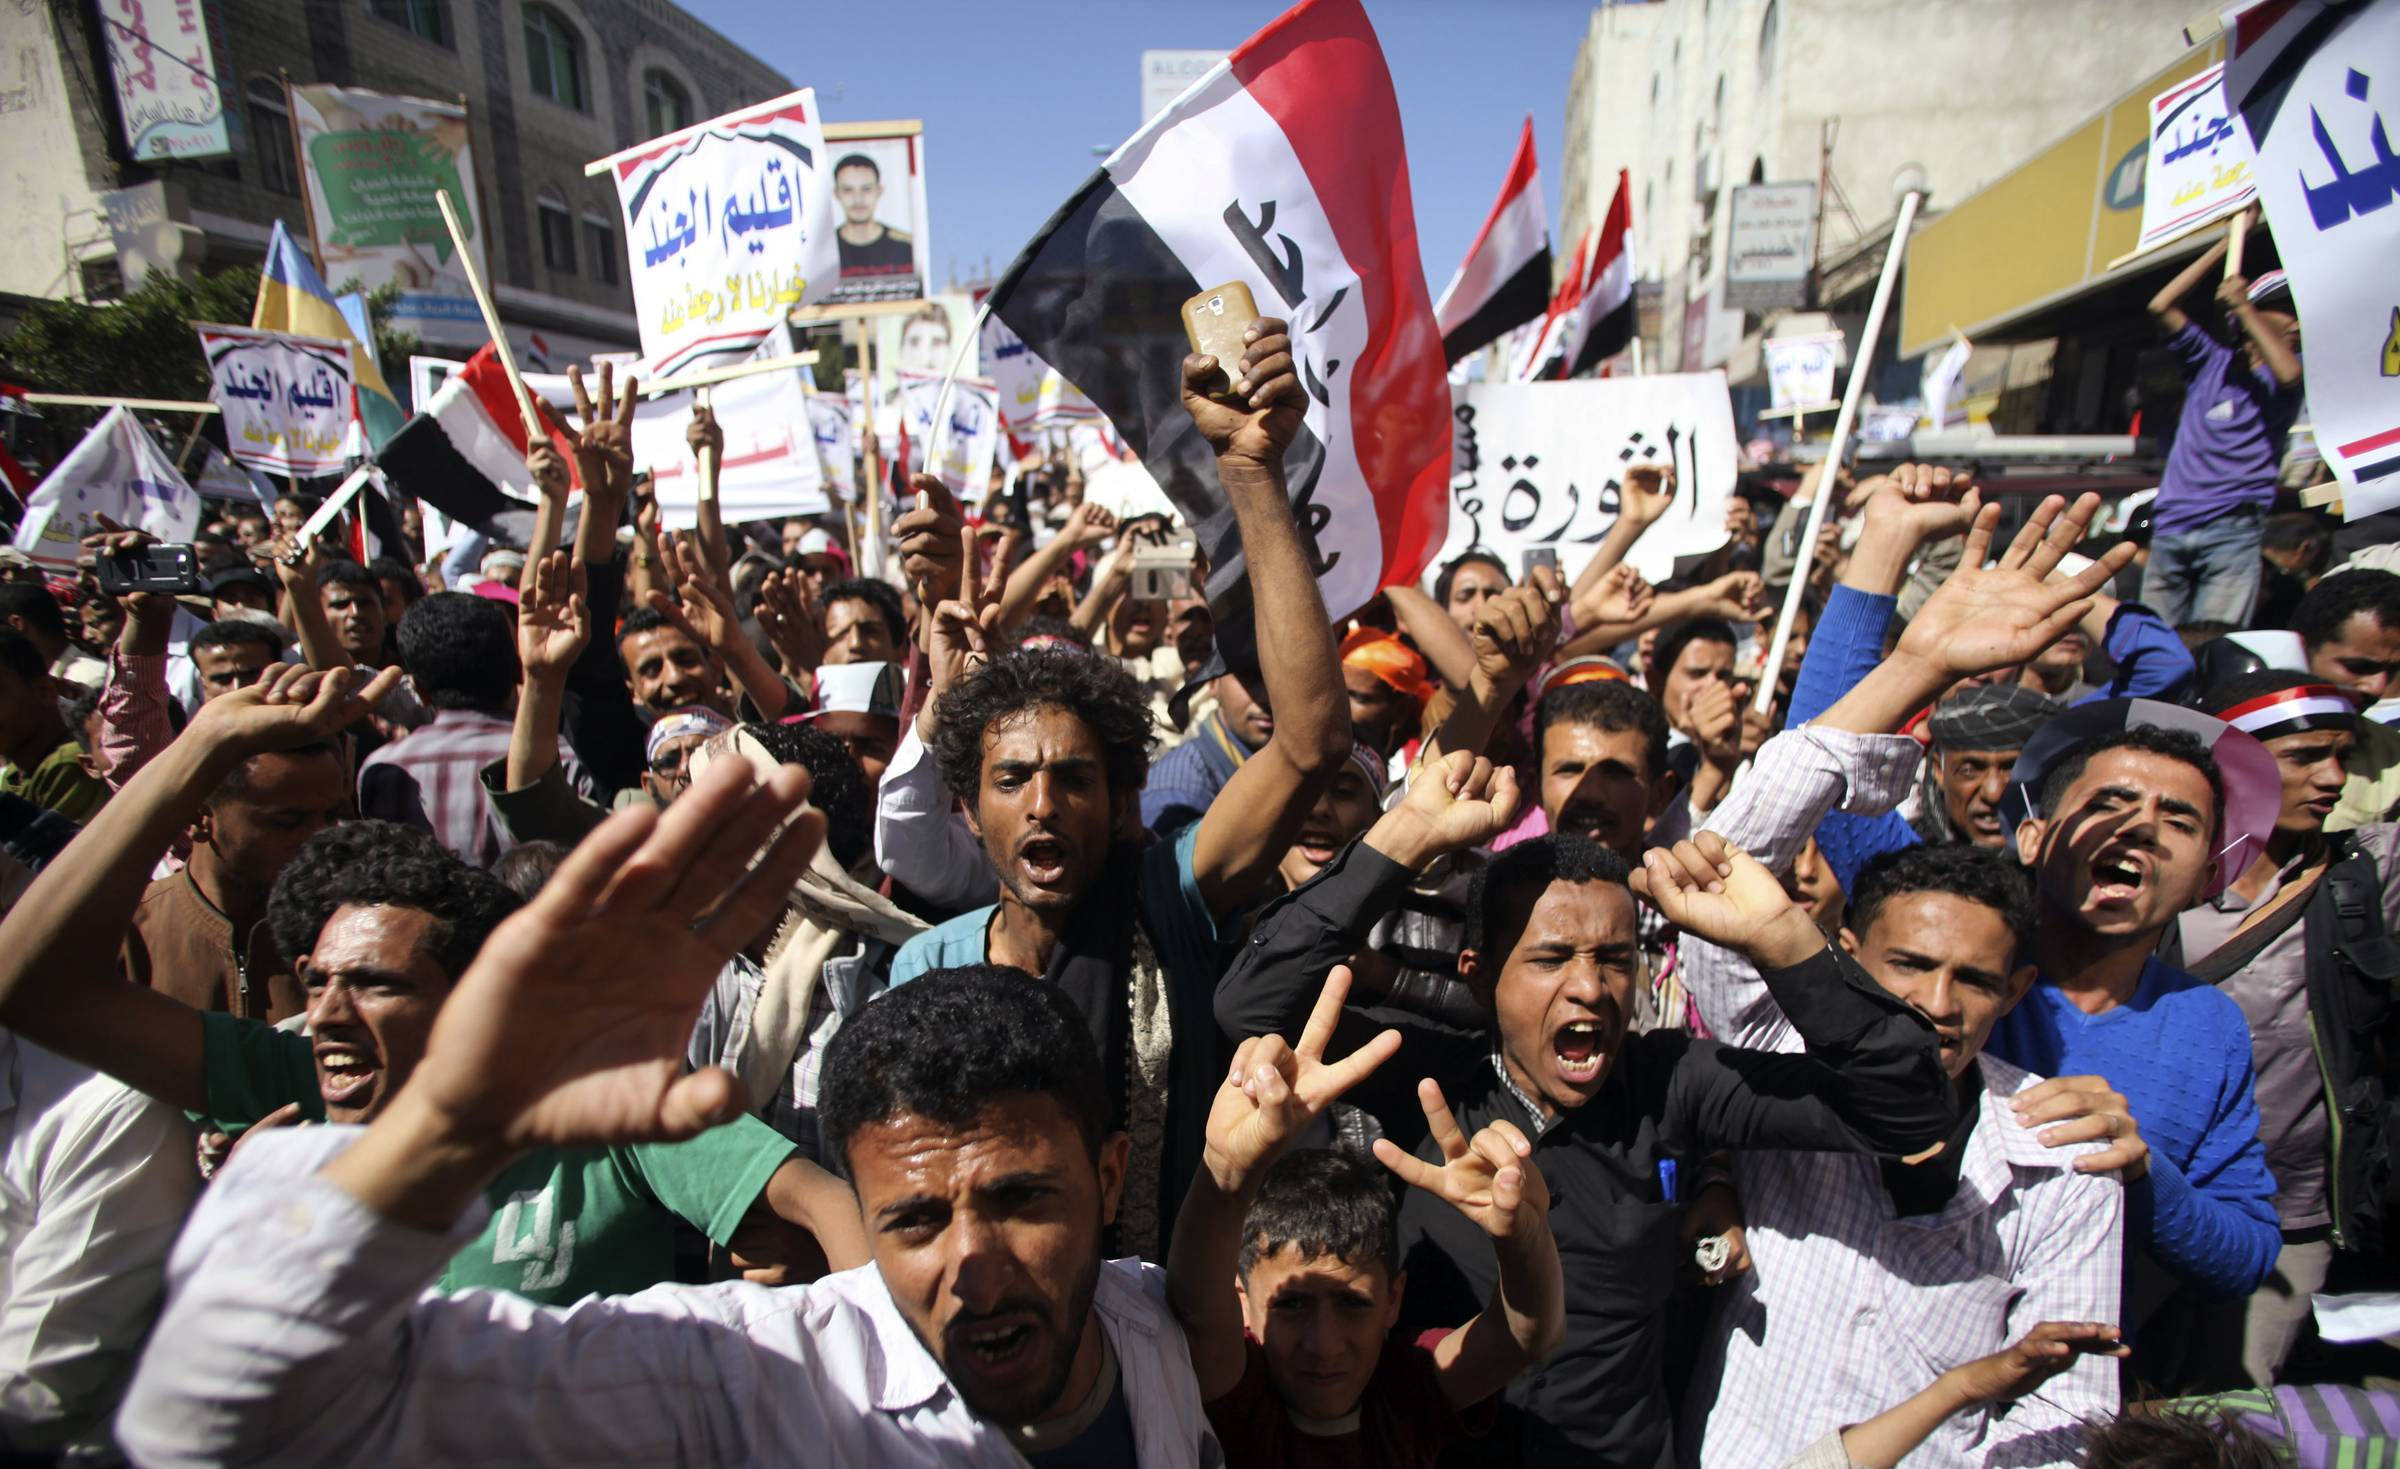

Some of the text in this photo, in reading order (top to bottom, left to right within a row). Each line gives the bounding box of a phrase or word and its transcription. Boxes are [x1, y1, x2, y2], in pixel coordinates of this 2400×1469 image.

[644, 180, 711, 269] الجند
[687, 282, 725, 326] رجعة
[726, 271, 742, 312] لا
[660, 298, 684, 335] عنه
[224, 360, 283, 412] الجند
